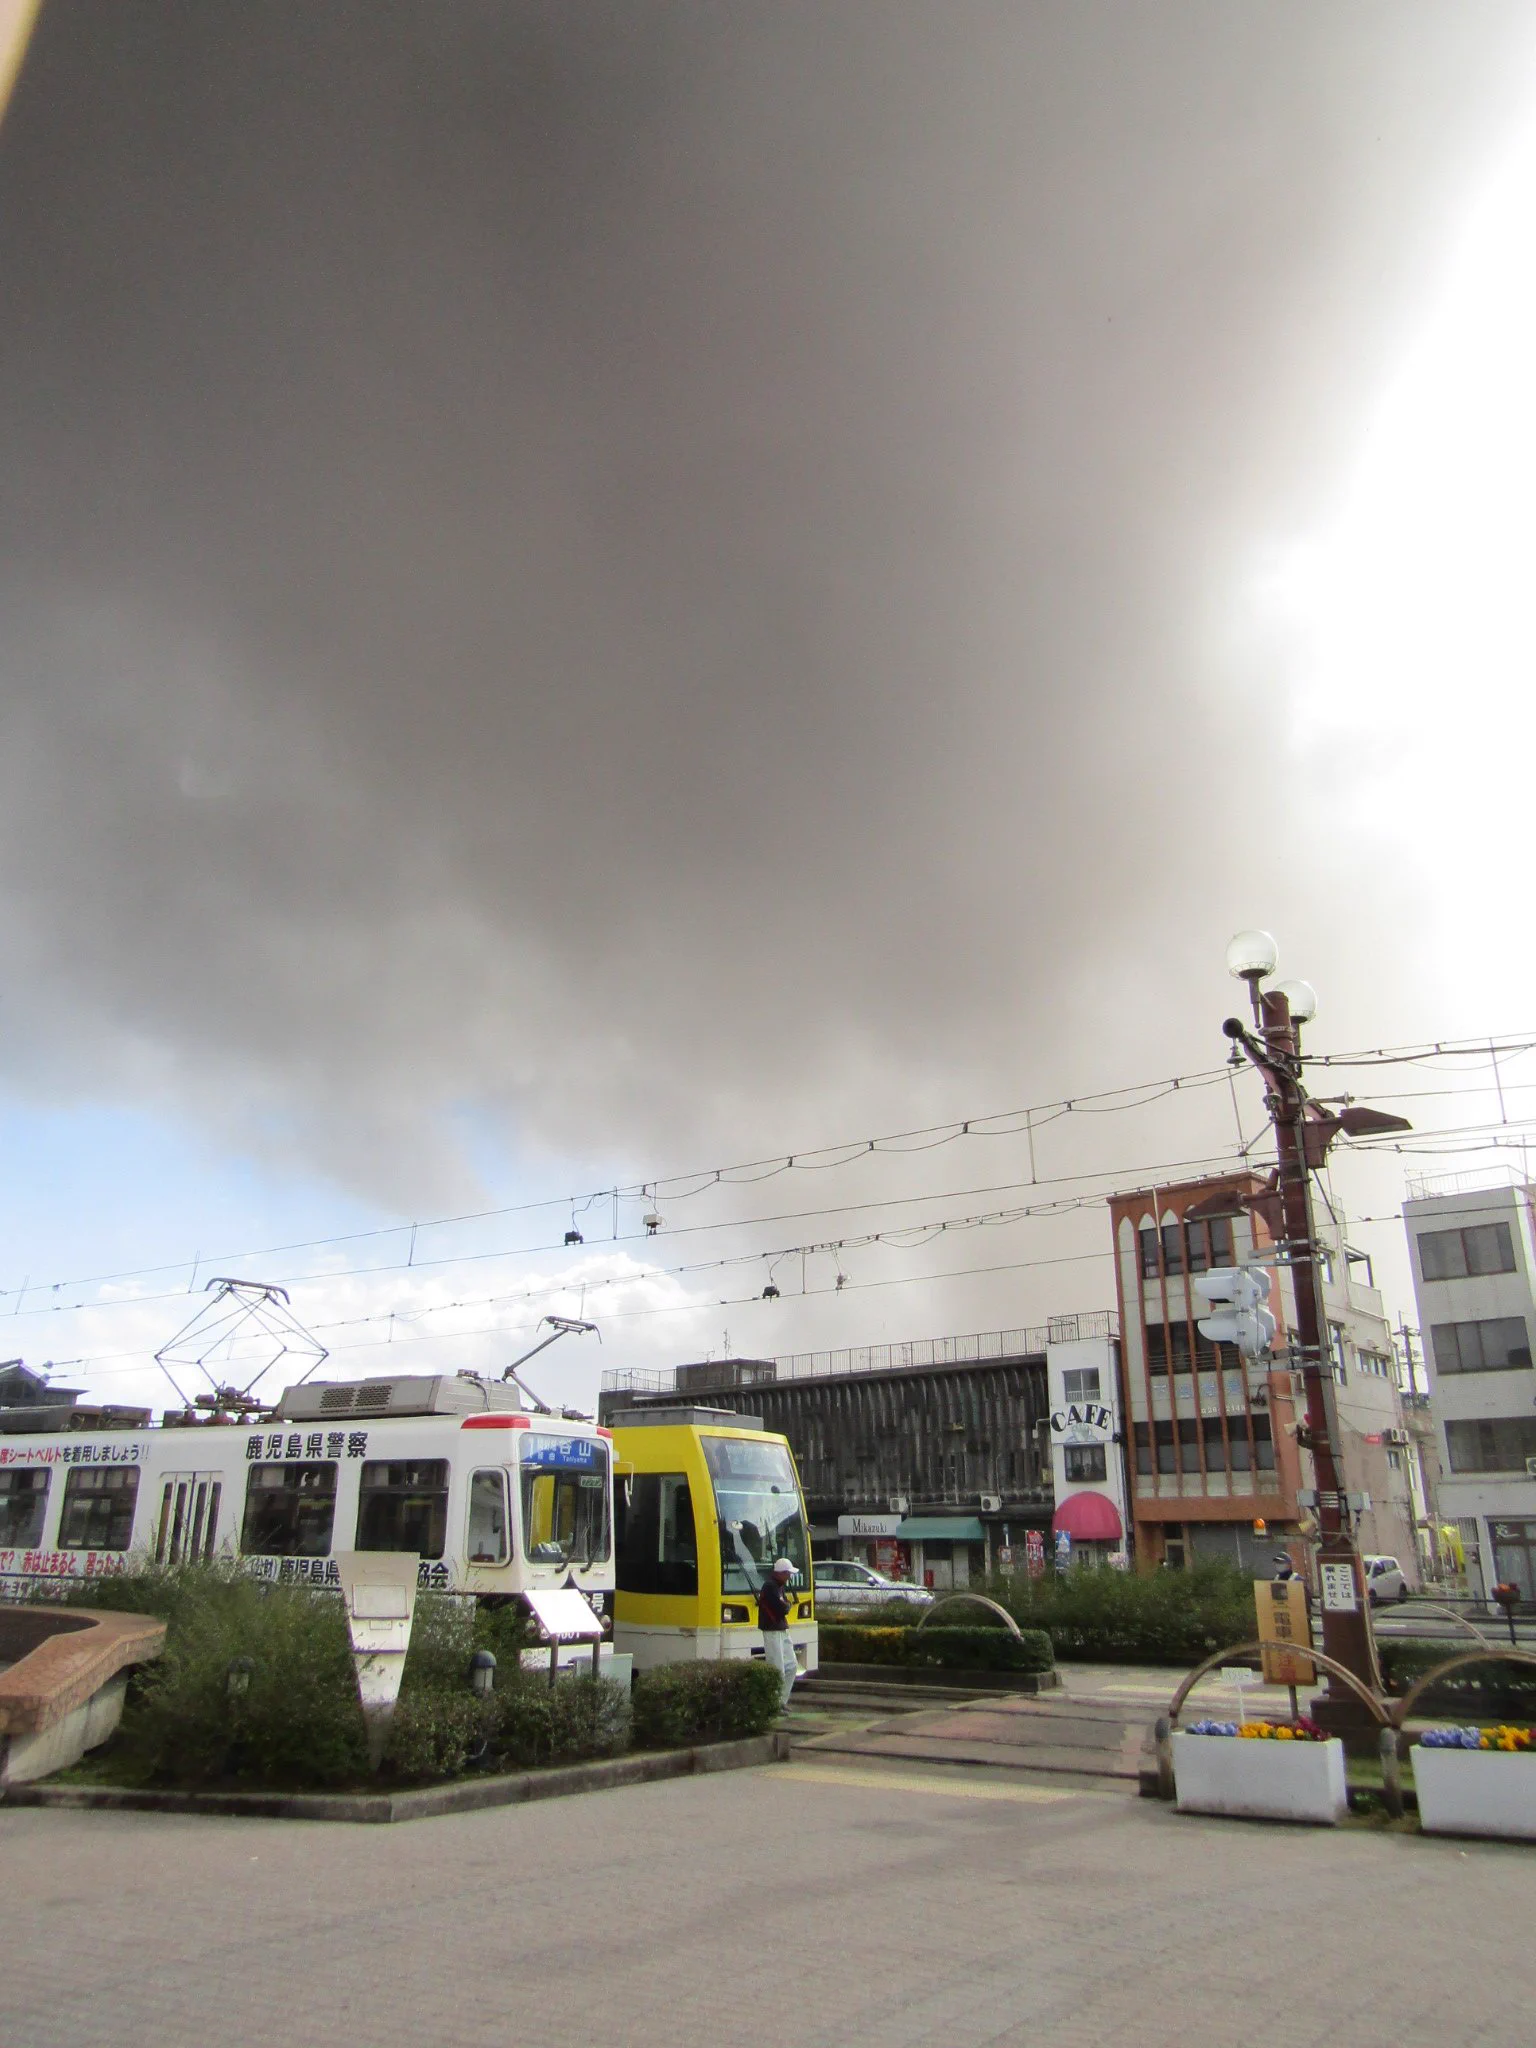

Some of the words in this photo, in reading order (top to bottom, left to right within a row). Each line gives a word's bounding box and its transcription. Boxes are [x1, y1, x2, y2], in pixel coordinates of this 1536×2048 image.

[1051, 1404, 1112, 1432] CAFE
[246, 1432, 368, 1460] 鹿児島県警察
[562, 1455, 587, 1464] Taniyama
[852, 1518, 887, 1533] Mikazuki
[1340, 1566, 1352, 1599] ここでは
